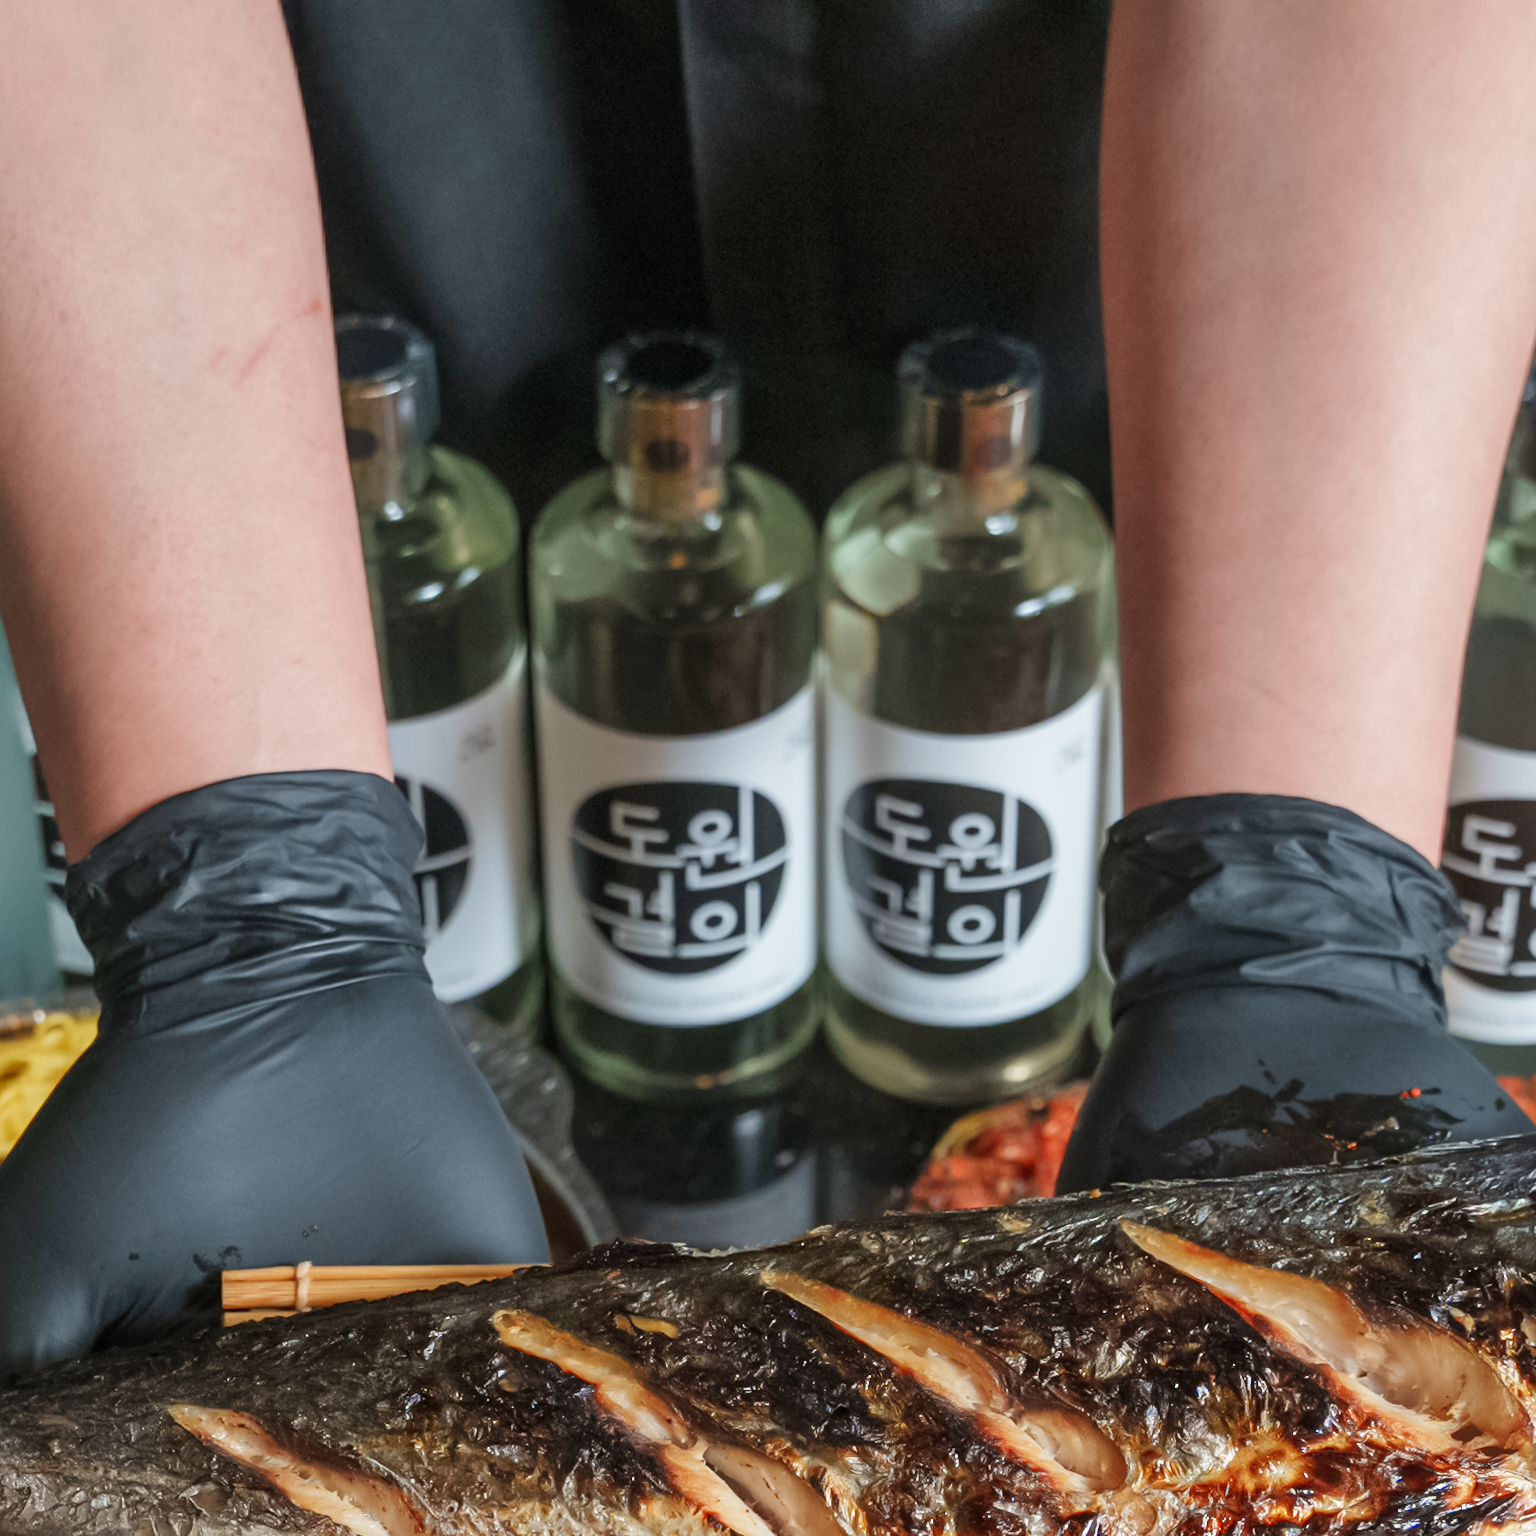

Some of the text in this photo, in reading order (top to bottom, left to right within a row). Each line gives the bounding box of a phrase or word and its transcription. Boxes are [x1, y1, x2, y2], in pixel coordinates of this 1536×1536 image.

[572, 785, 792, 890] 도원
[844, 794, 1054, 892] 도원
[586, 869, 764, 958] 결의
[860, 869, 1022, 960] 결의
